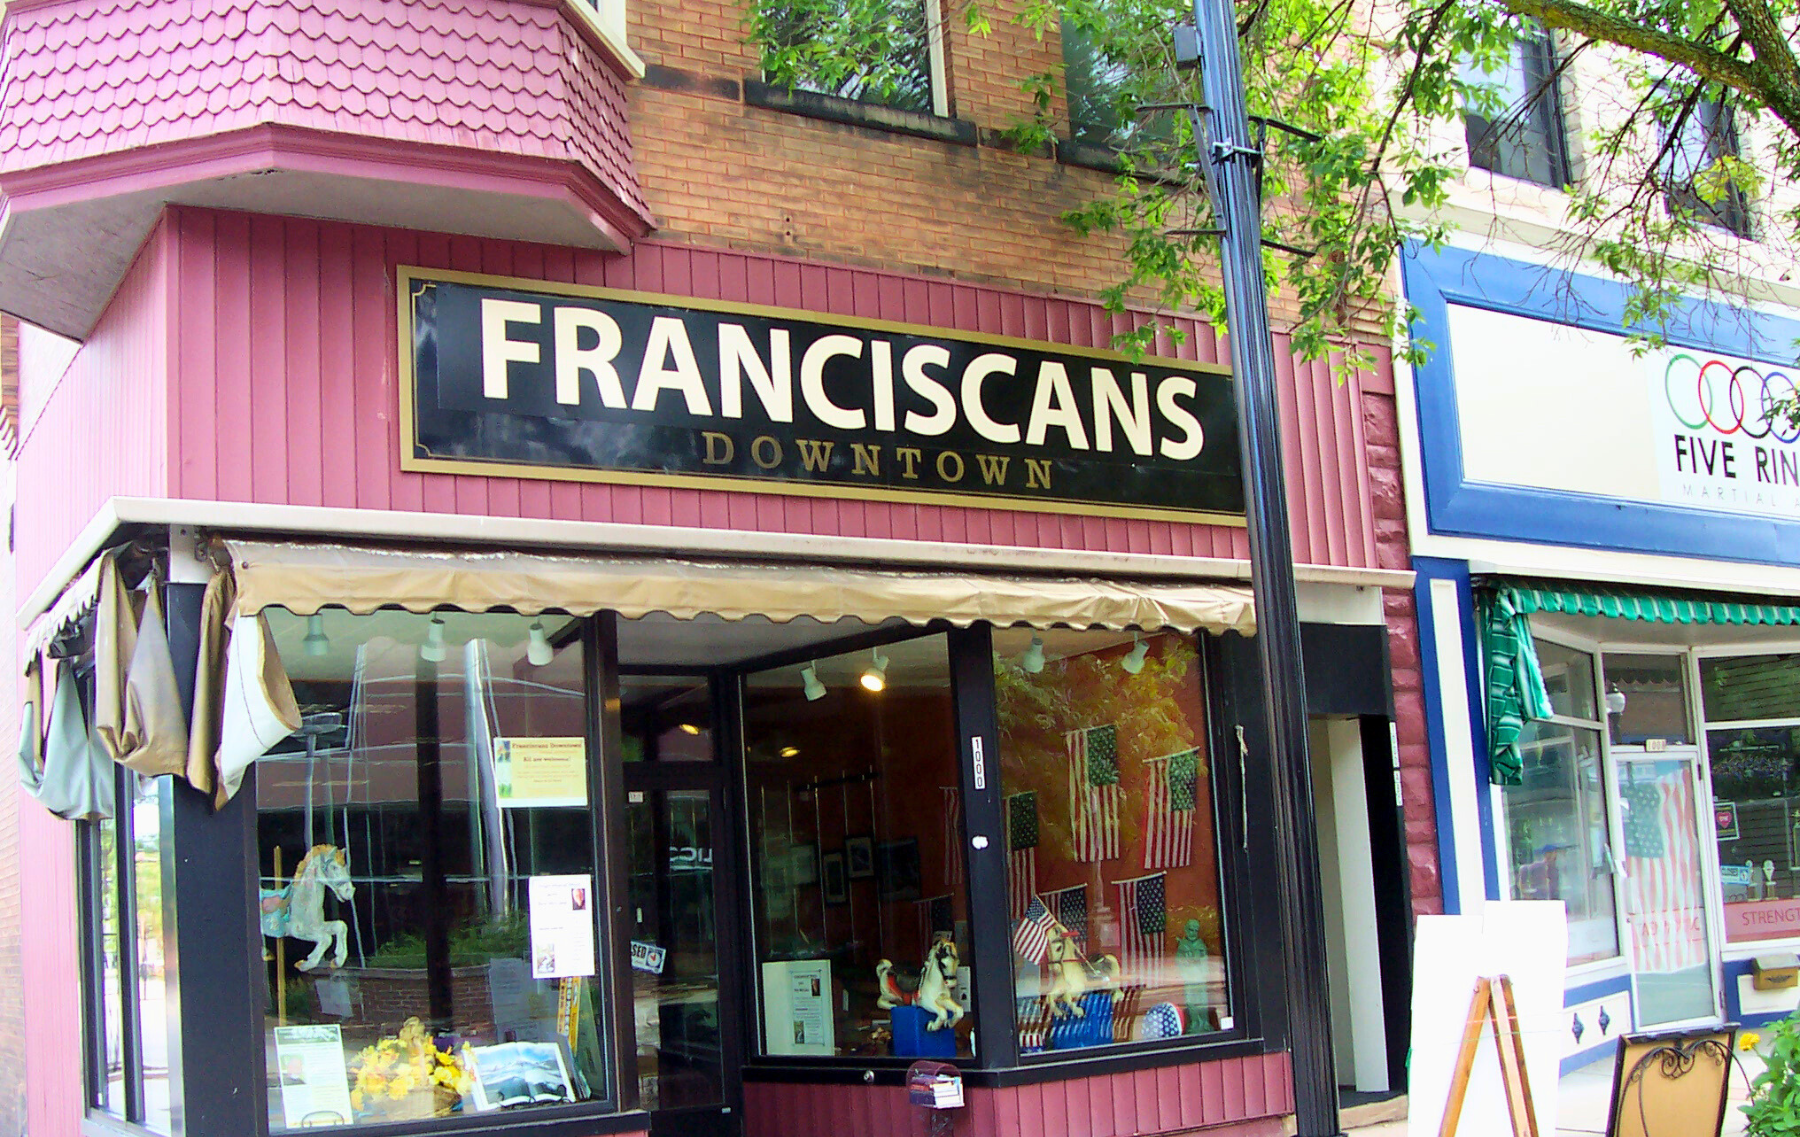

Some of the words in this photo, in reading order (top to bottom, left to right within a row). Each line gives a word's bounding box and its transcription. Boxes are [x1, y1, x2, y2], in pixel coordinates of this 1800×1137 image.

[480, 297, 1205, 462] FRANCISCANS
[701, 431, 1053, 489] DOWNTOWN
[1674, 434, 1737, 479] FIVE
[1683, 484, 1776, 507] MARTIAL
[974, 738, 983, 788] 1000
